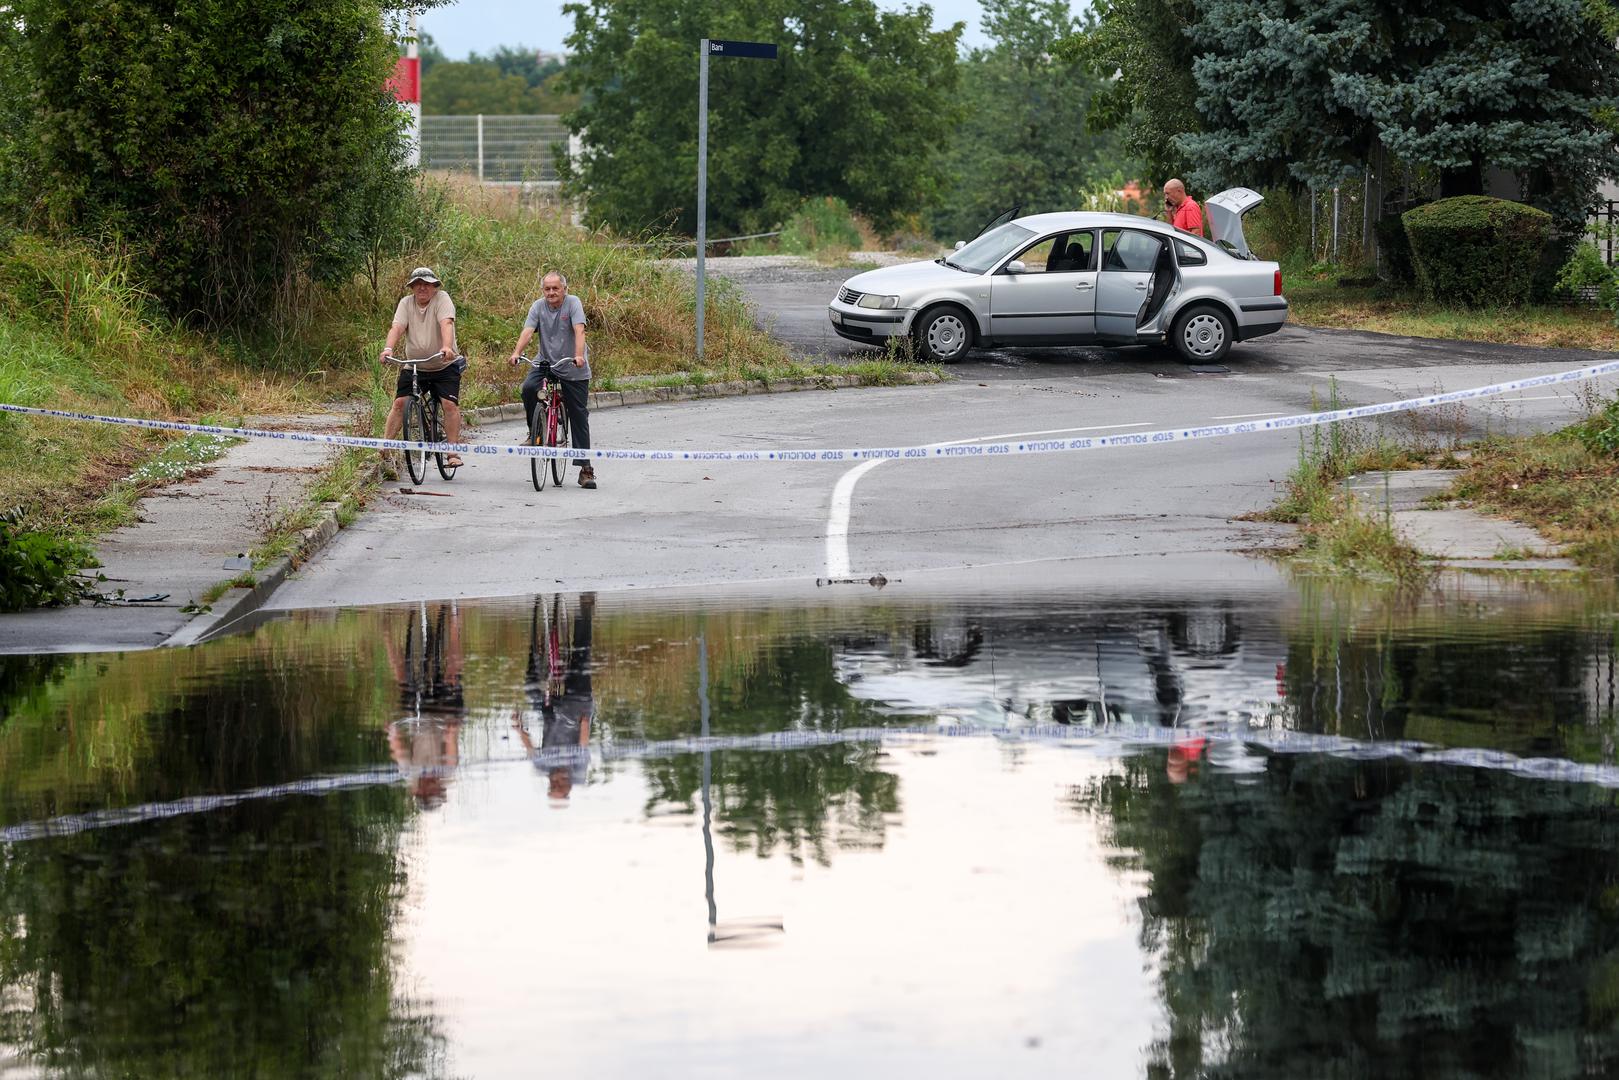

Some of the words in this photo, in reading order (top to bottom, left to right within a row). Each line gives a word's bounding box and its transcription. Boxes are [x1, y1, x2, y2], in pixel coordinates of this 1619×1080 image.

[711, 43, 724, 52] Bani
[1192, 427, 1230, 437] POLICIJA
[1234, 423, 1257, 433] STOP
[1109, 434, 1148, 445] POLICIJA
[1152, 432, 1175, 442] STOP
[987, 444, 1009, 454] STOP
[1027, 441, 1065, 452] POLICIJA
[1070, 439, 1092, 449] STOP
[474, 445, 498, 455] STOP
[517, 447, 558, 458] POLICIJA
[563, 449, 586, 458] STOP
[862, 449, 900, 459] POLICIJA
[905, 448, 927, 458] STOP
[945, 446, 983, 456] POLICIJA
[651, 451, 673, 460] STOP
[778, 451, 816, 460] POLICIJA
[821, 451, 844, 460] STOP
